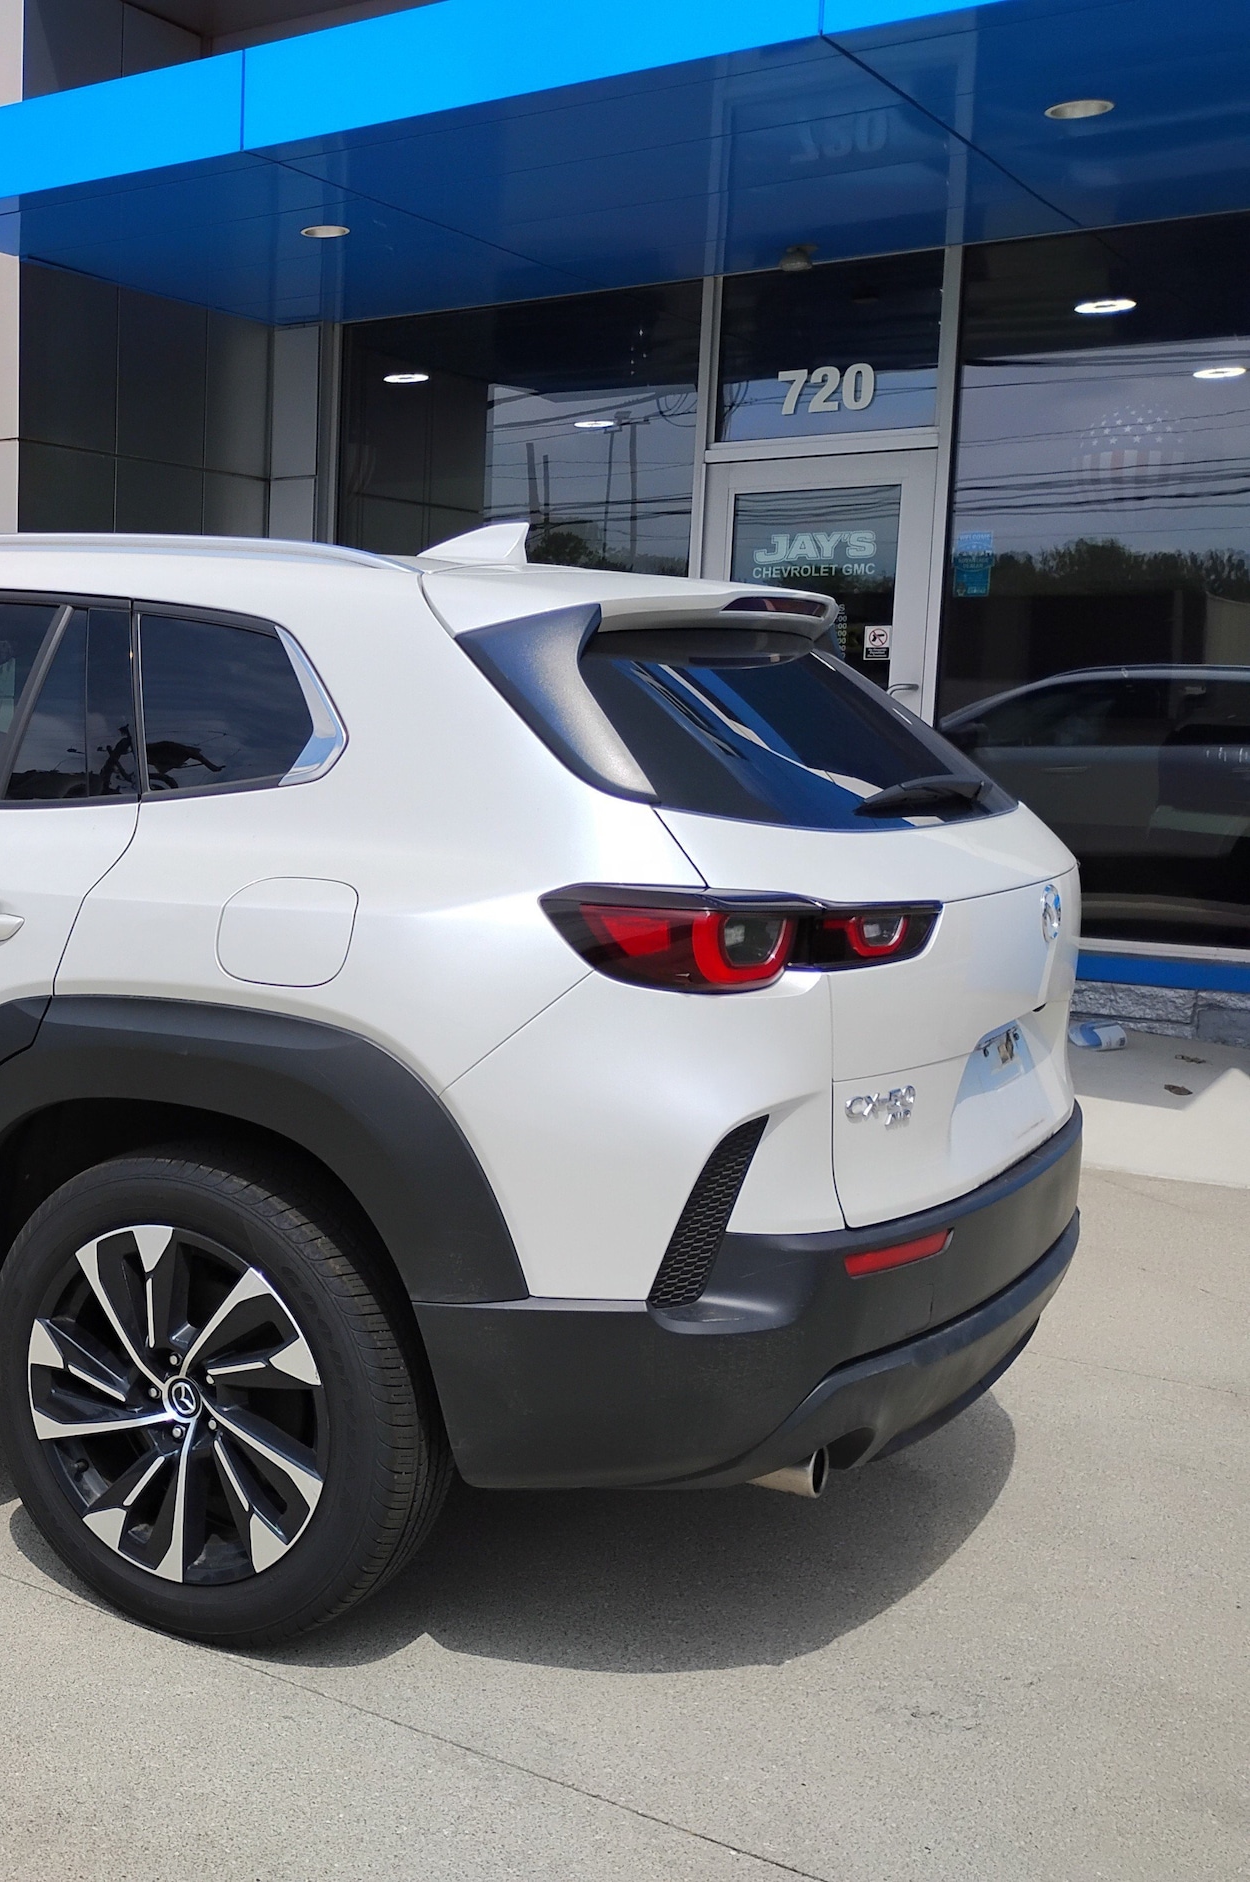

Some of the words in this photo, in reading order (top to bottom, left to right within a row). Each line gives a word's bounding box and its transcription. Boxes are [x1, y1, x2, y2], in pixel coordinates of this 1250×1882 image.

[777, 362, 875, 415] 720
[753, 530, 877, 565] JAY'S
[752, 564, 838, 579] CHEVROLET
[842, 563, 876, 576] GMC
